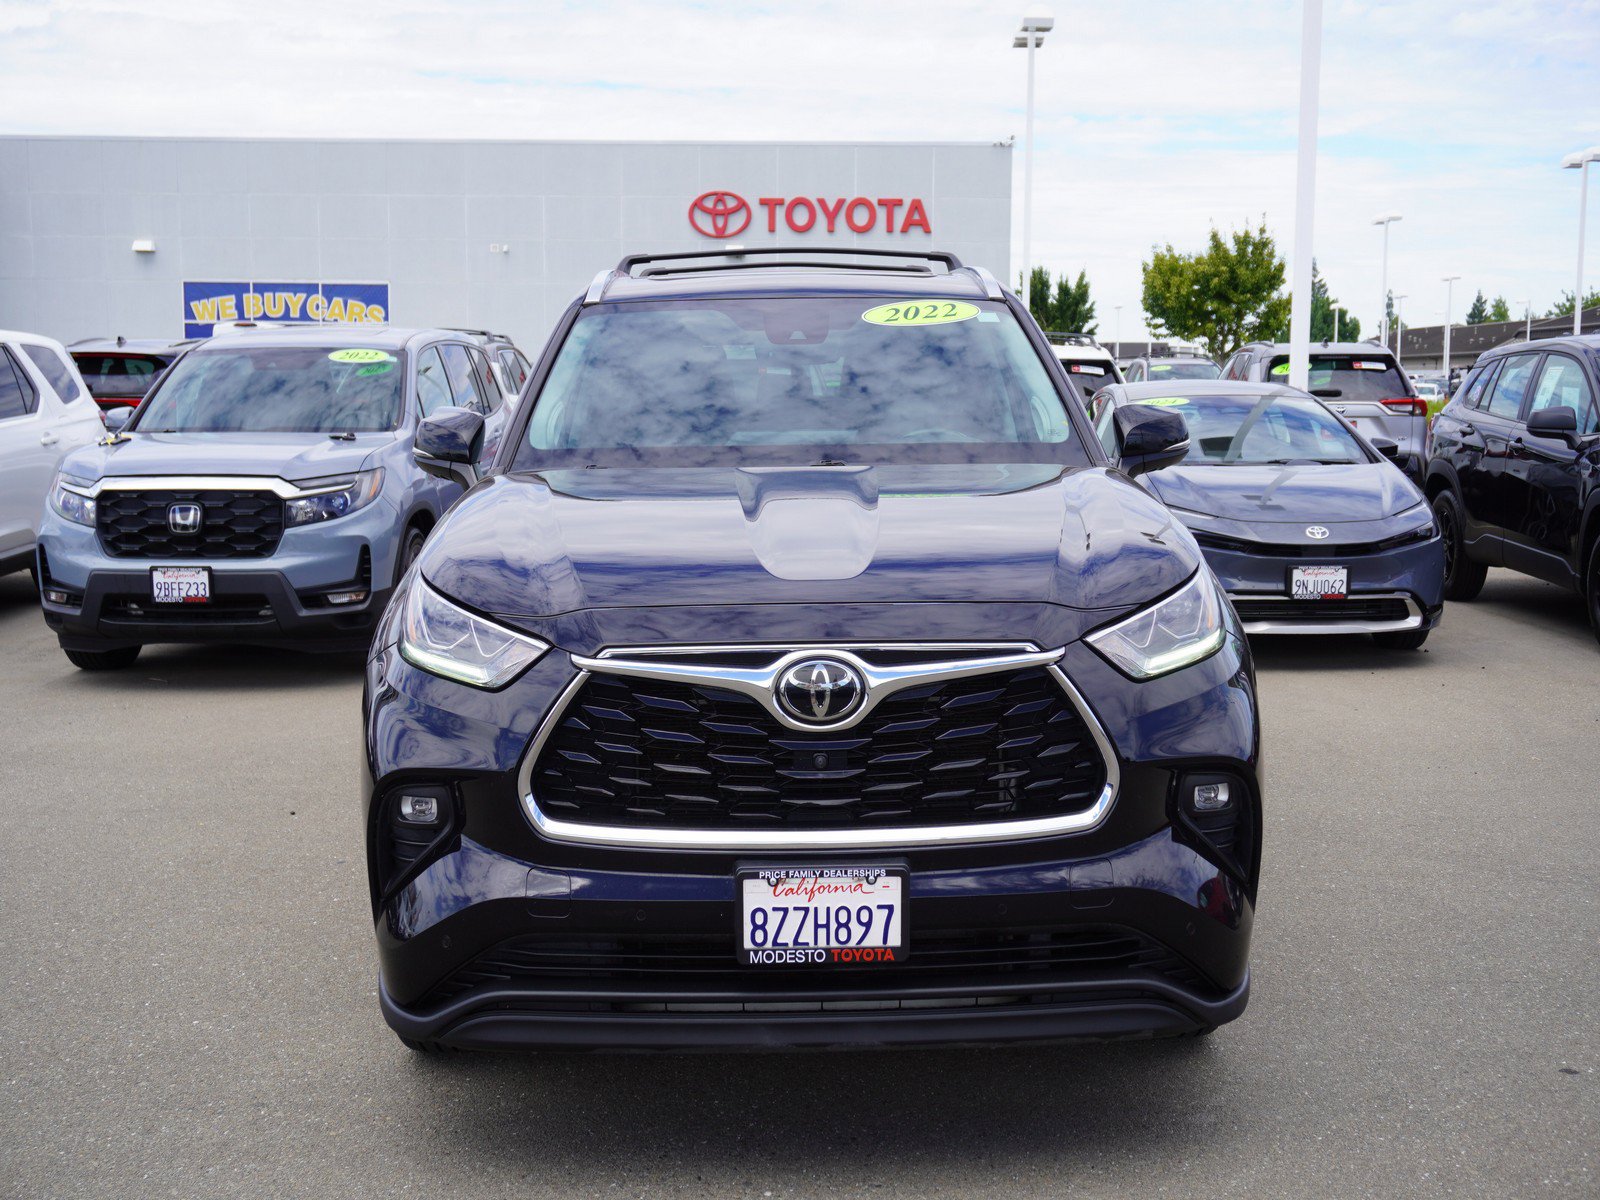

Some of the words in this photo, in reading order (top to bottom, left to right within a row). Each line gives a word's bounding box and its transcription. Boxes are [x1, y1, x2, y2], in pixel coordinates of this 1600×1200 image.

[759, 197, 931, 233] TOYOTA
[190, 295, 238, 323] WE
[243, 292, 307, 318] BUY
[306, 294, 385, 324] CARS
[883, 303, 958, 323] 2022
[155, 582, 207, 598] 9BFF233
[1294, 579, 1345, 595] 9NJU062
[759, 871, 787, 879] PRICE
[788, 870, 821, 878] FAMILY
[823, 869, 887, 878] DEALERSHIPS
[772, 877, 875, 903] California
[750, 904, 895, 948] 8ZZH897
[750, 950, 826, 964] MODESTO
[830, 948, 895, 962] TOYOTA
